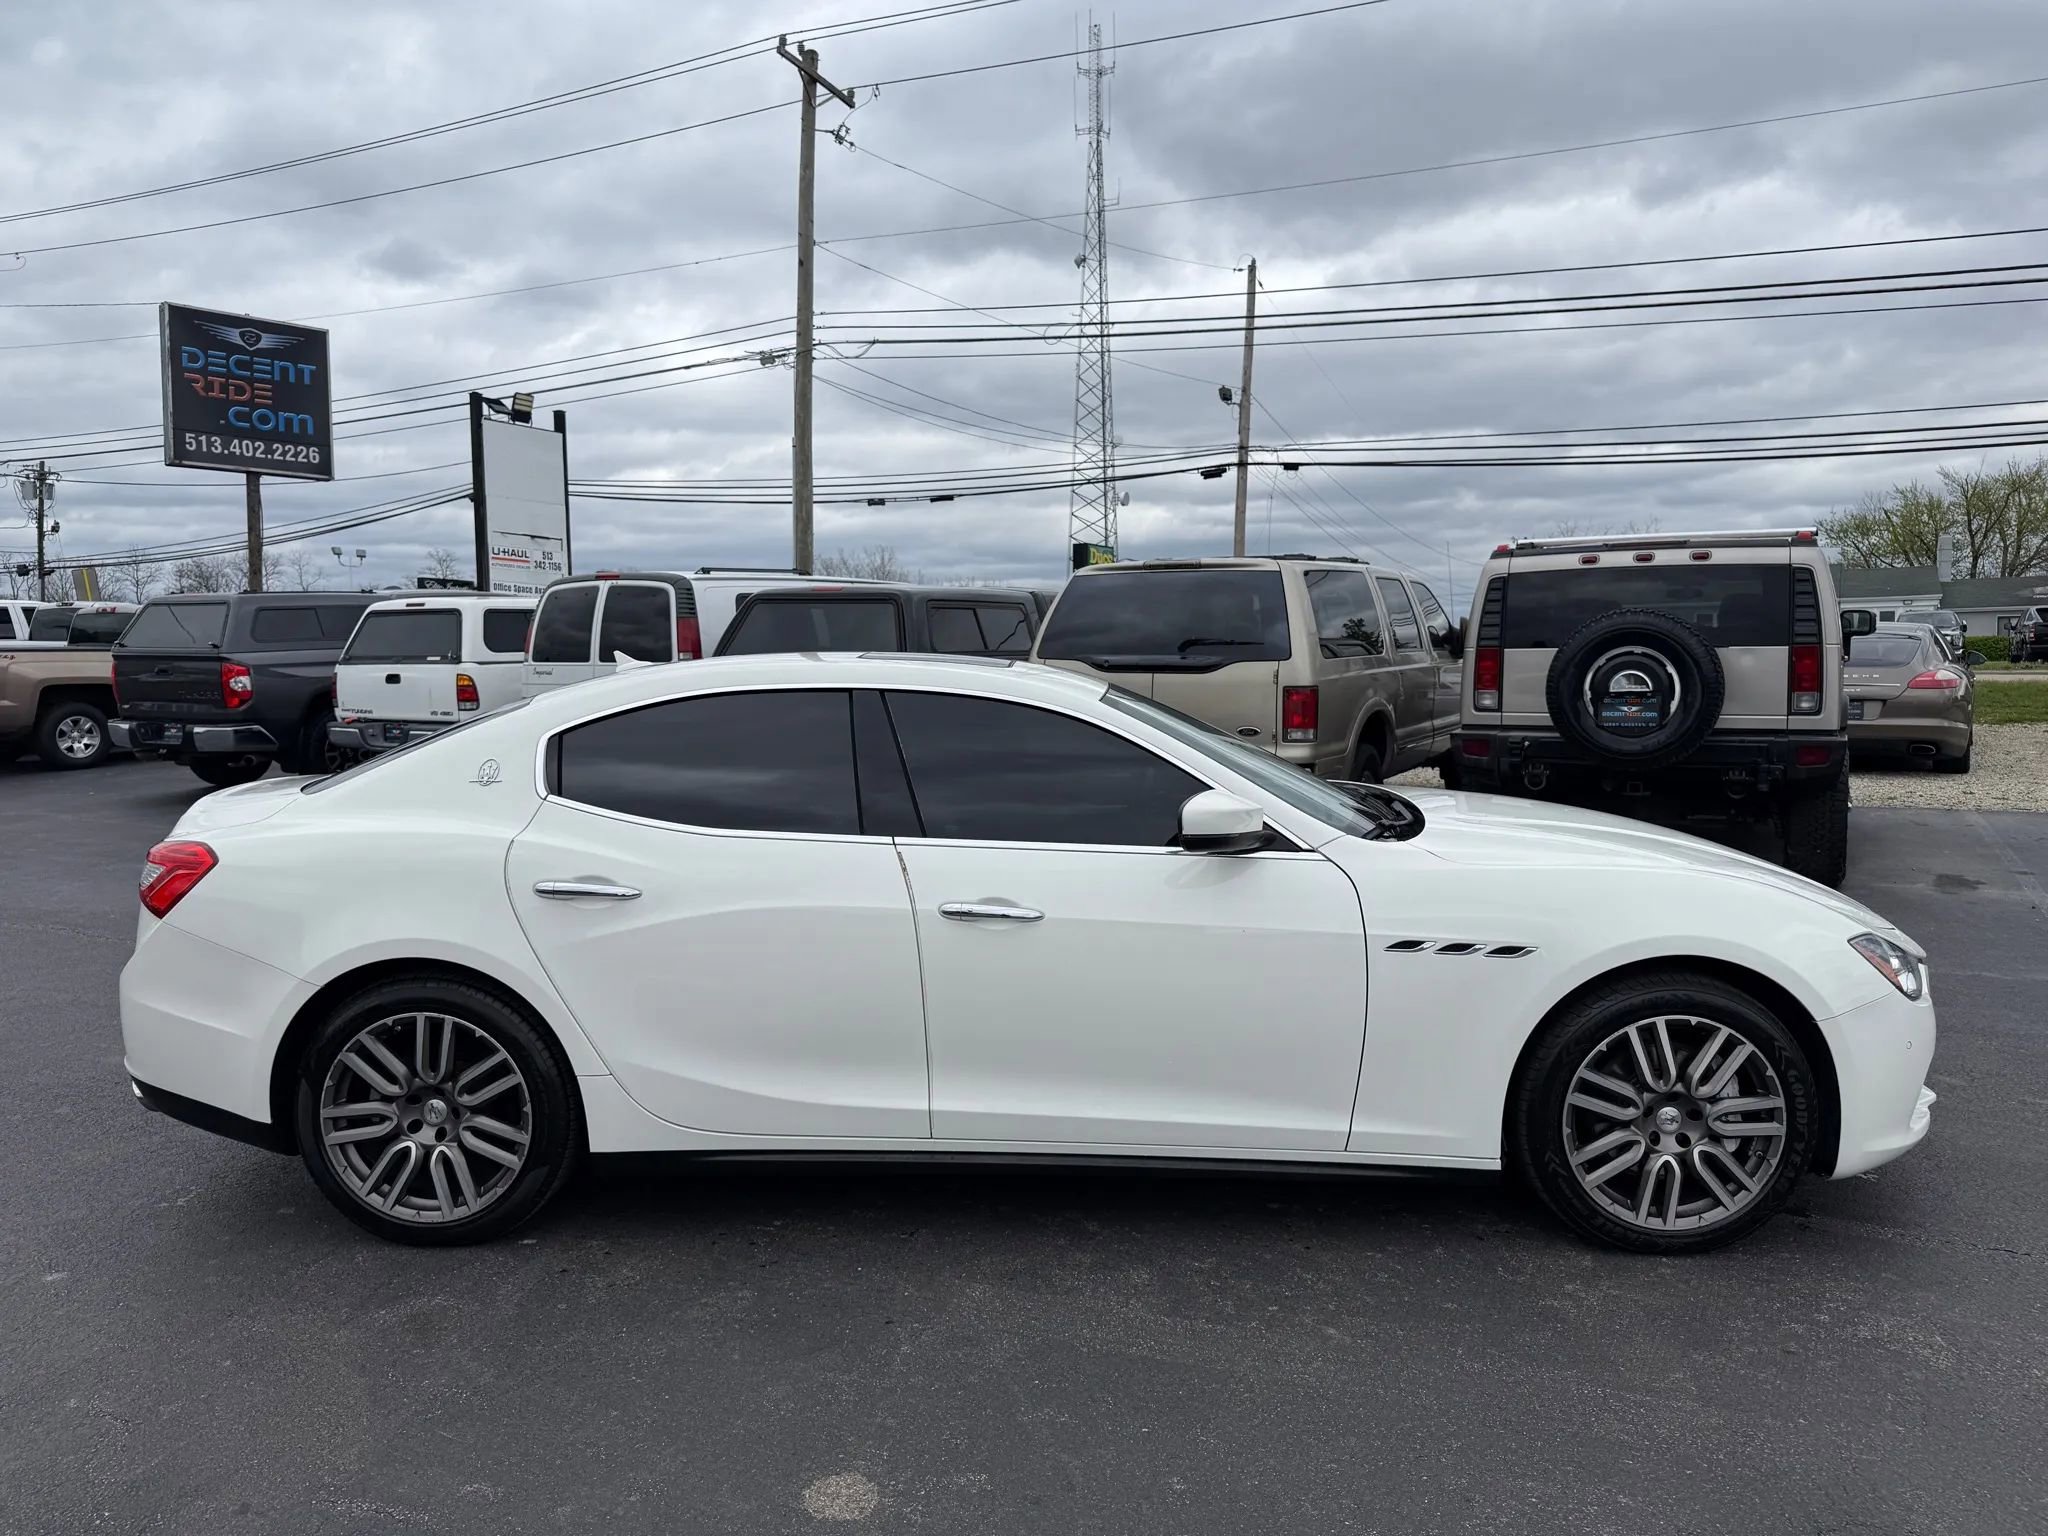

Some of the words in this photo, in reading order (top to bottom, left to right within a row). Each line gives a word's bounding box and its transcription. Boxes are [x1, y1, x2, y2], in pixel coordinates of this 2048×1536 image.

[183, 372, 273, 405] RIDE
[185, 432, 320, 464] 513.402.2226
[492, 547, 530, 559] U-HAUL
[542, 551, 553, 561] 513
[534, 560, 562, 572] 342-1156
[493, 582, 512, 592] Office
[513, 584, 533, 594] Space
